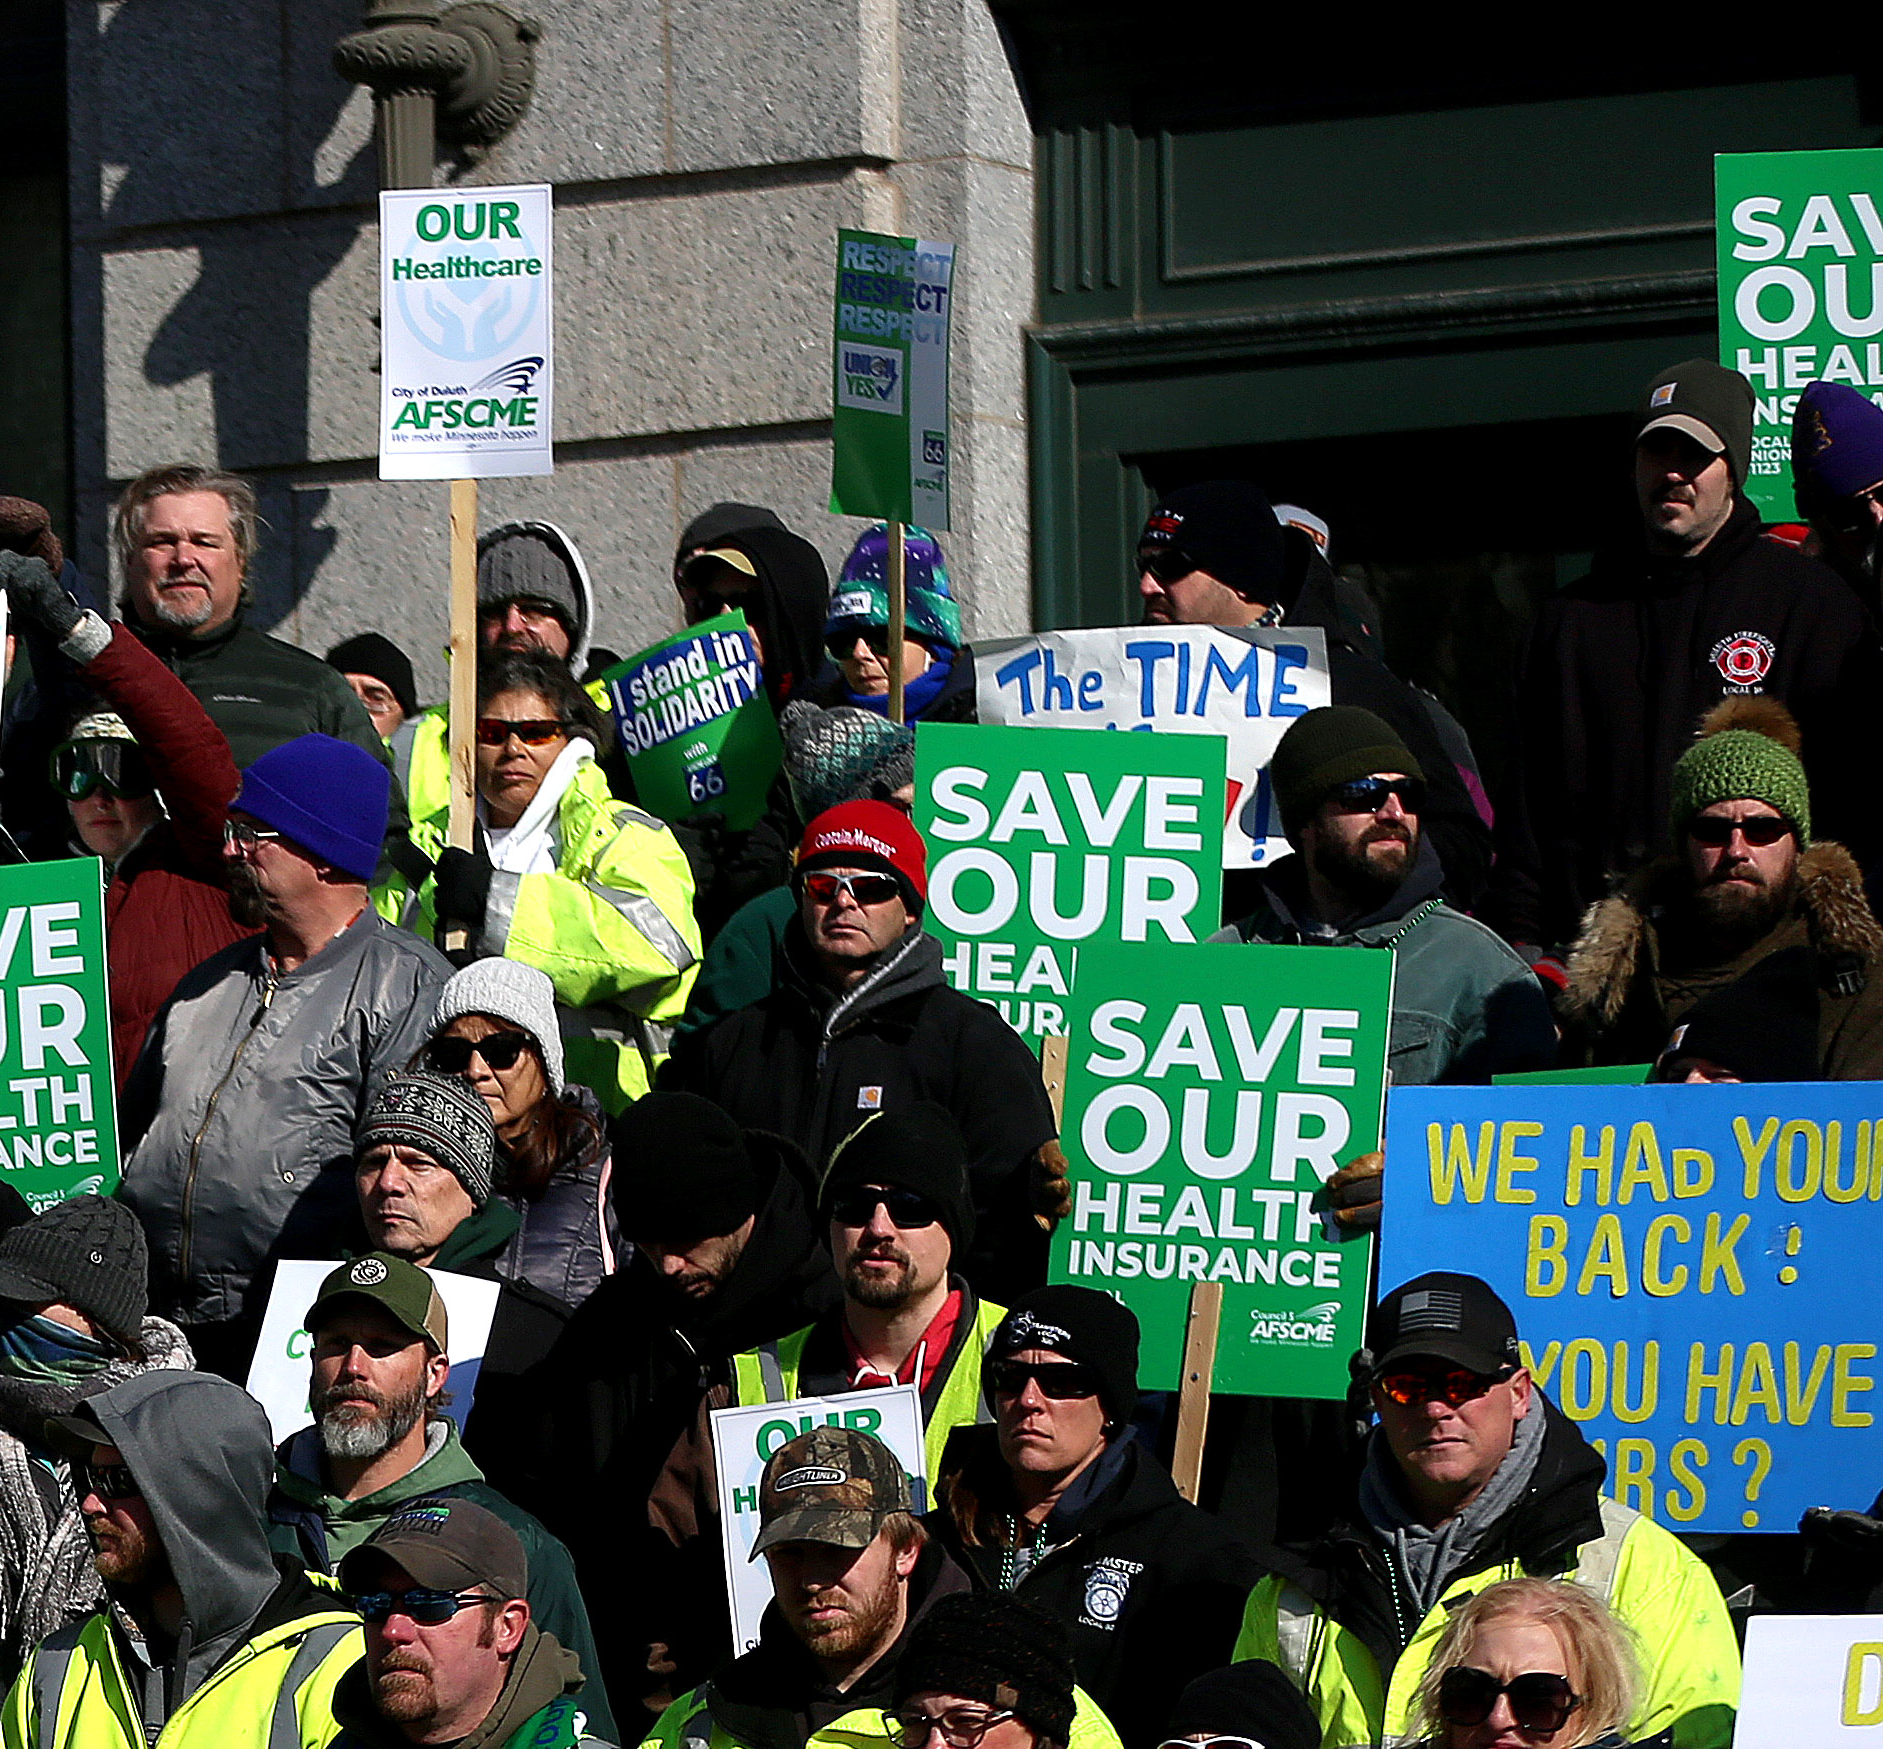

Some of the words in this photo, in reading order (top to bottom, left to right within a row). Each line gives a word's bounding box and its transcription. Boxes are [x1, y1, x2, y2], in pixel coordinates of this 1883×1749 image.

[416, 202, 522, 241] OUR
[1730, 194, 1883, 262] SAV
[392, 256, 542, 281] Healthcare
[843, 241, 950, 284] RESPECT
[842, 273, 947, 313] RESPECT
[1734, 264, 1883, 341] OU
[840, 303, 945, 344] RESPECT
[845, 375, 875, 399] YES
[1736, 343, 1883, 390] HEAL
[392, 397, 538, 430] AFSCME
[1751, 436, 1791, 449] OCAL
[1751, 449, 1792, 461] NION
[1749, 462, 1781, 475] 1123
[611, 680, 627, 716] I
[630, 639, 709, 708] stand
[710, 631, 747, 669] in
[996, 648, 1104, 717] The
[1126, 641, 1310, 718] TIME
[621, 662, 758, 757] SOLIDARITY
[684, 742, 708, 759] with
[690, 768, 724, 801] 66
[928, 766, 1203, 851] SAVE
[927, 847, 1200, 944] OUR
[942, 942, 1078, 996] HEA
[1086, 1000, 1360, 1086] SAVE
[1080, 1084, 1351, 1182] OUR
[1426, 1121, 1543, 1205] WE
[1564, 1122, 1715, 1207] HAD
[1732, 1115, 1883, 1203] YOU
[1068, 1240, 1342, 1288] INSURANCE
[1249, 1320, 1336, 1342] AFSCME
[1250, 1309, 1287, 1320] Council
[1520, 1337, 1659, 1424] YOU
[1686, 1340, 1877, 1428] HAVE
